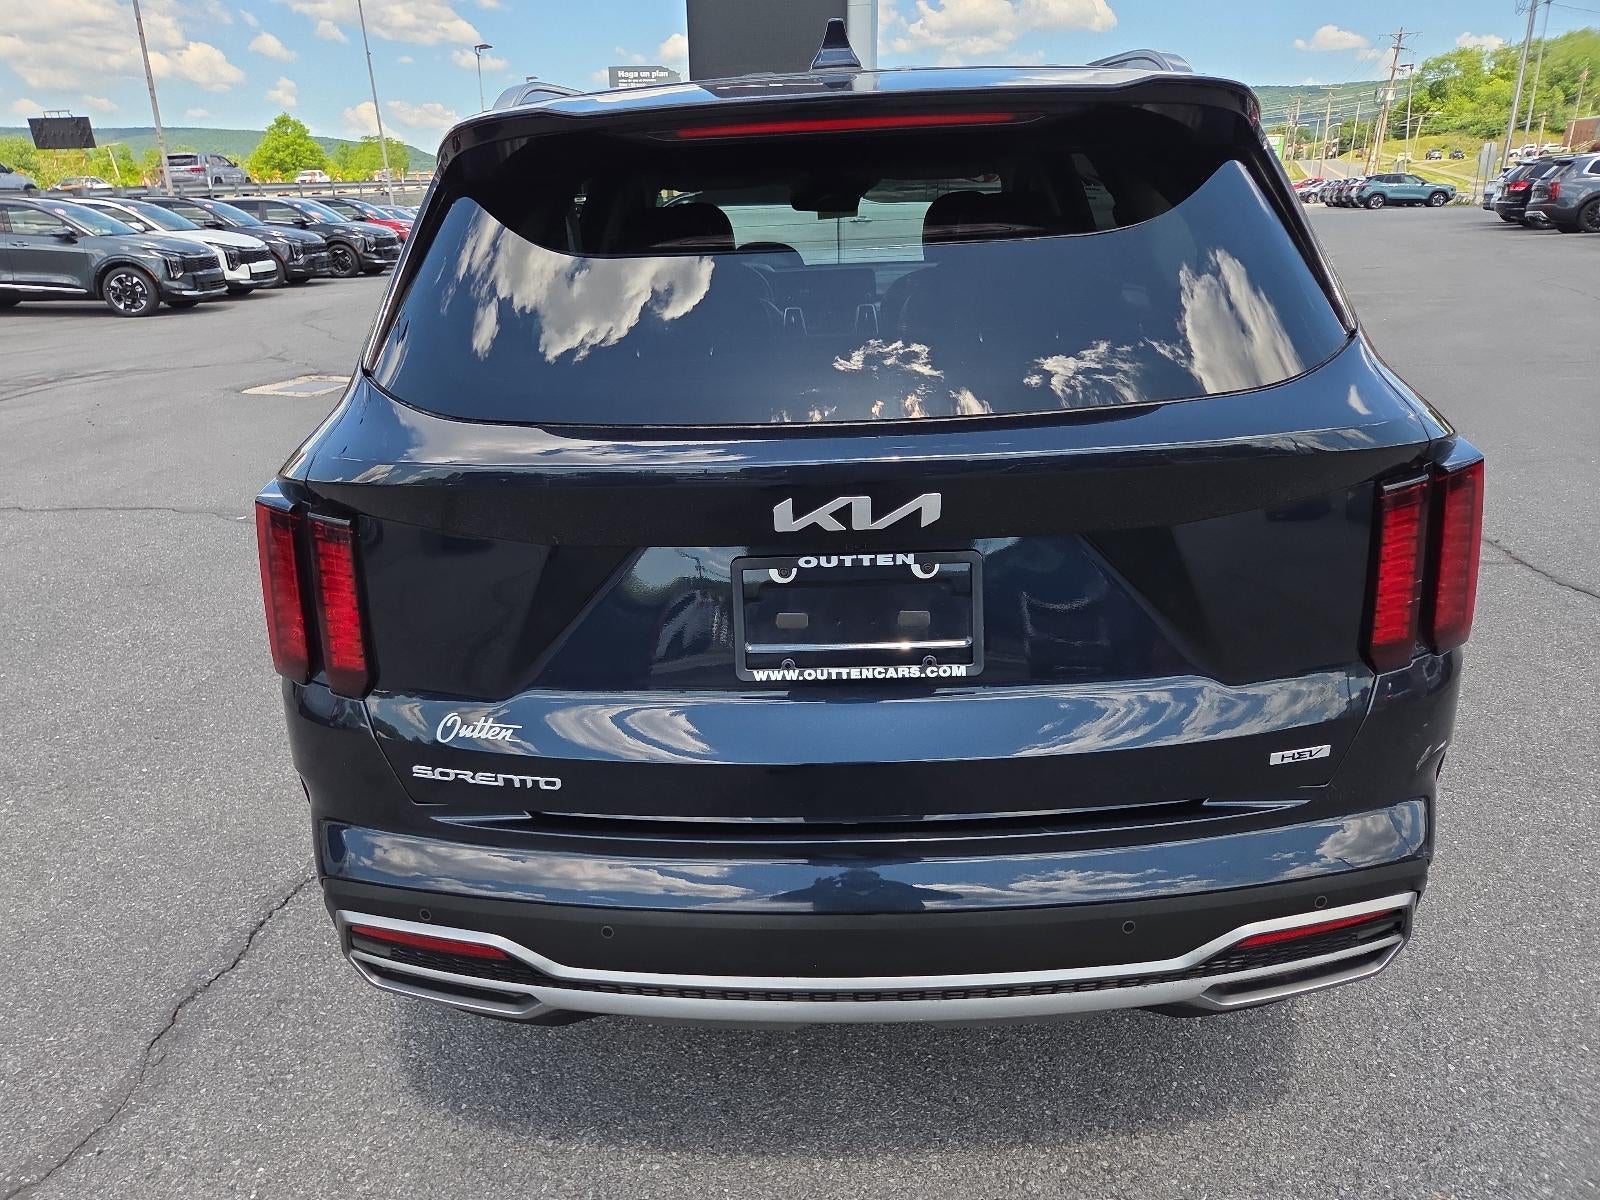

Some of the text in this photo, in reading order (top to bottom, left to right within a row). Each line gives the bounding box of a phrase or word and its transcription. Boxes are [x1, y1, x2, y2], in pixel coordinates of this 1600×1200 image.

[618, 70, 638, 78] Haga
[652, 70, 668, 78] plan
[773, 493, 941, 532] KIA
[798, 553, 914, 568] OUTTEN
[753, 665, 967, 681] WWW.OUTTENCARS.COM
[436, 712, 523, 743] Outten
[1281, 747, 1324, 762] HEV
[412, 765, 562, 790] SORENTO
